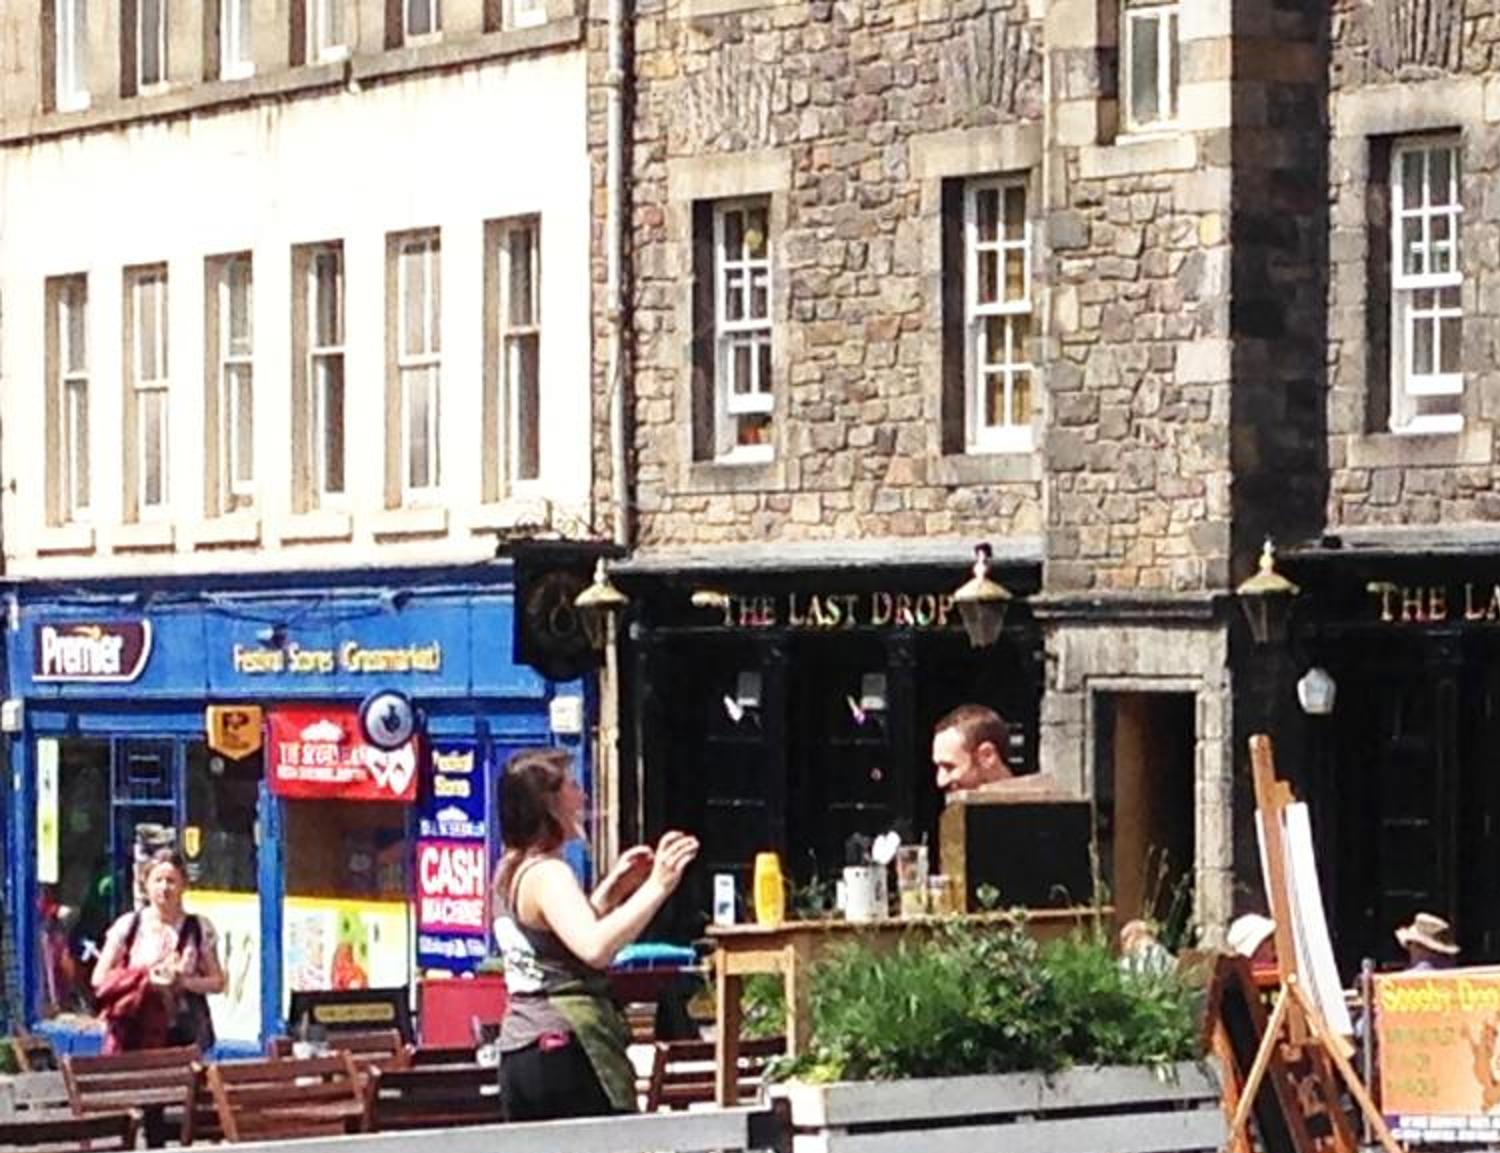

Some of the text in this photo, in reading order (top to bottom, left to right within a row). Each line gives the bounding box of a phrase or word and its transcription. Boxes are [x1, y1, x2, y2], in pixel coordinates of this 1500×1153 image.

[716, 590, 954, 627] THE LAST DROP
[1366, 581, 1448, 621] THE
[41, 625, 123, 676] Premier
[421, 845, 484, 896] CASH
